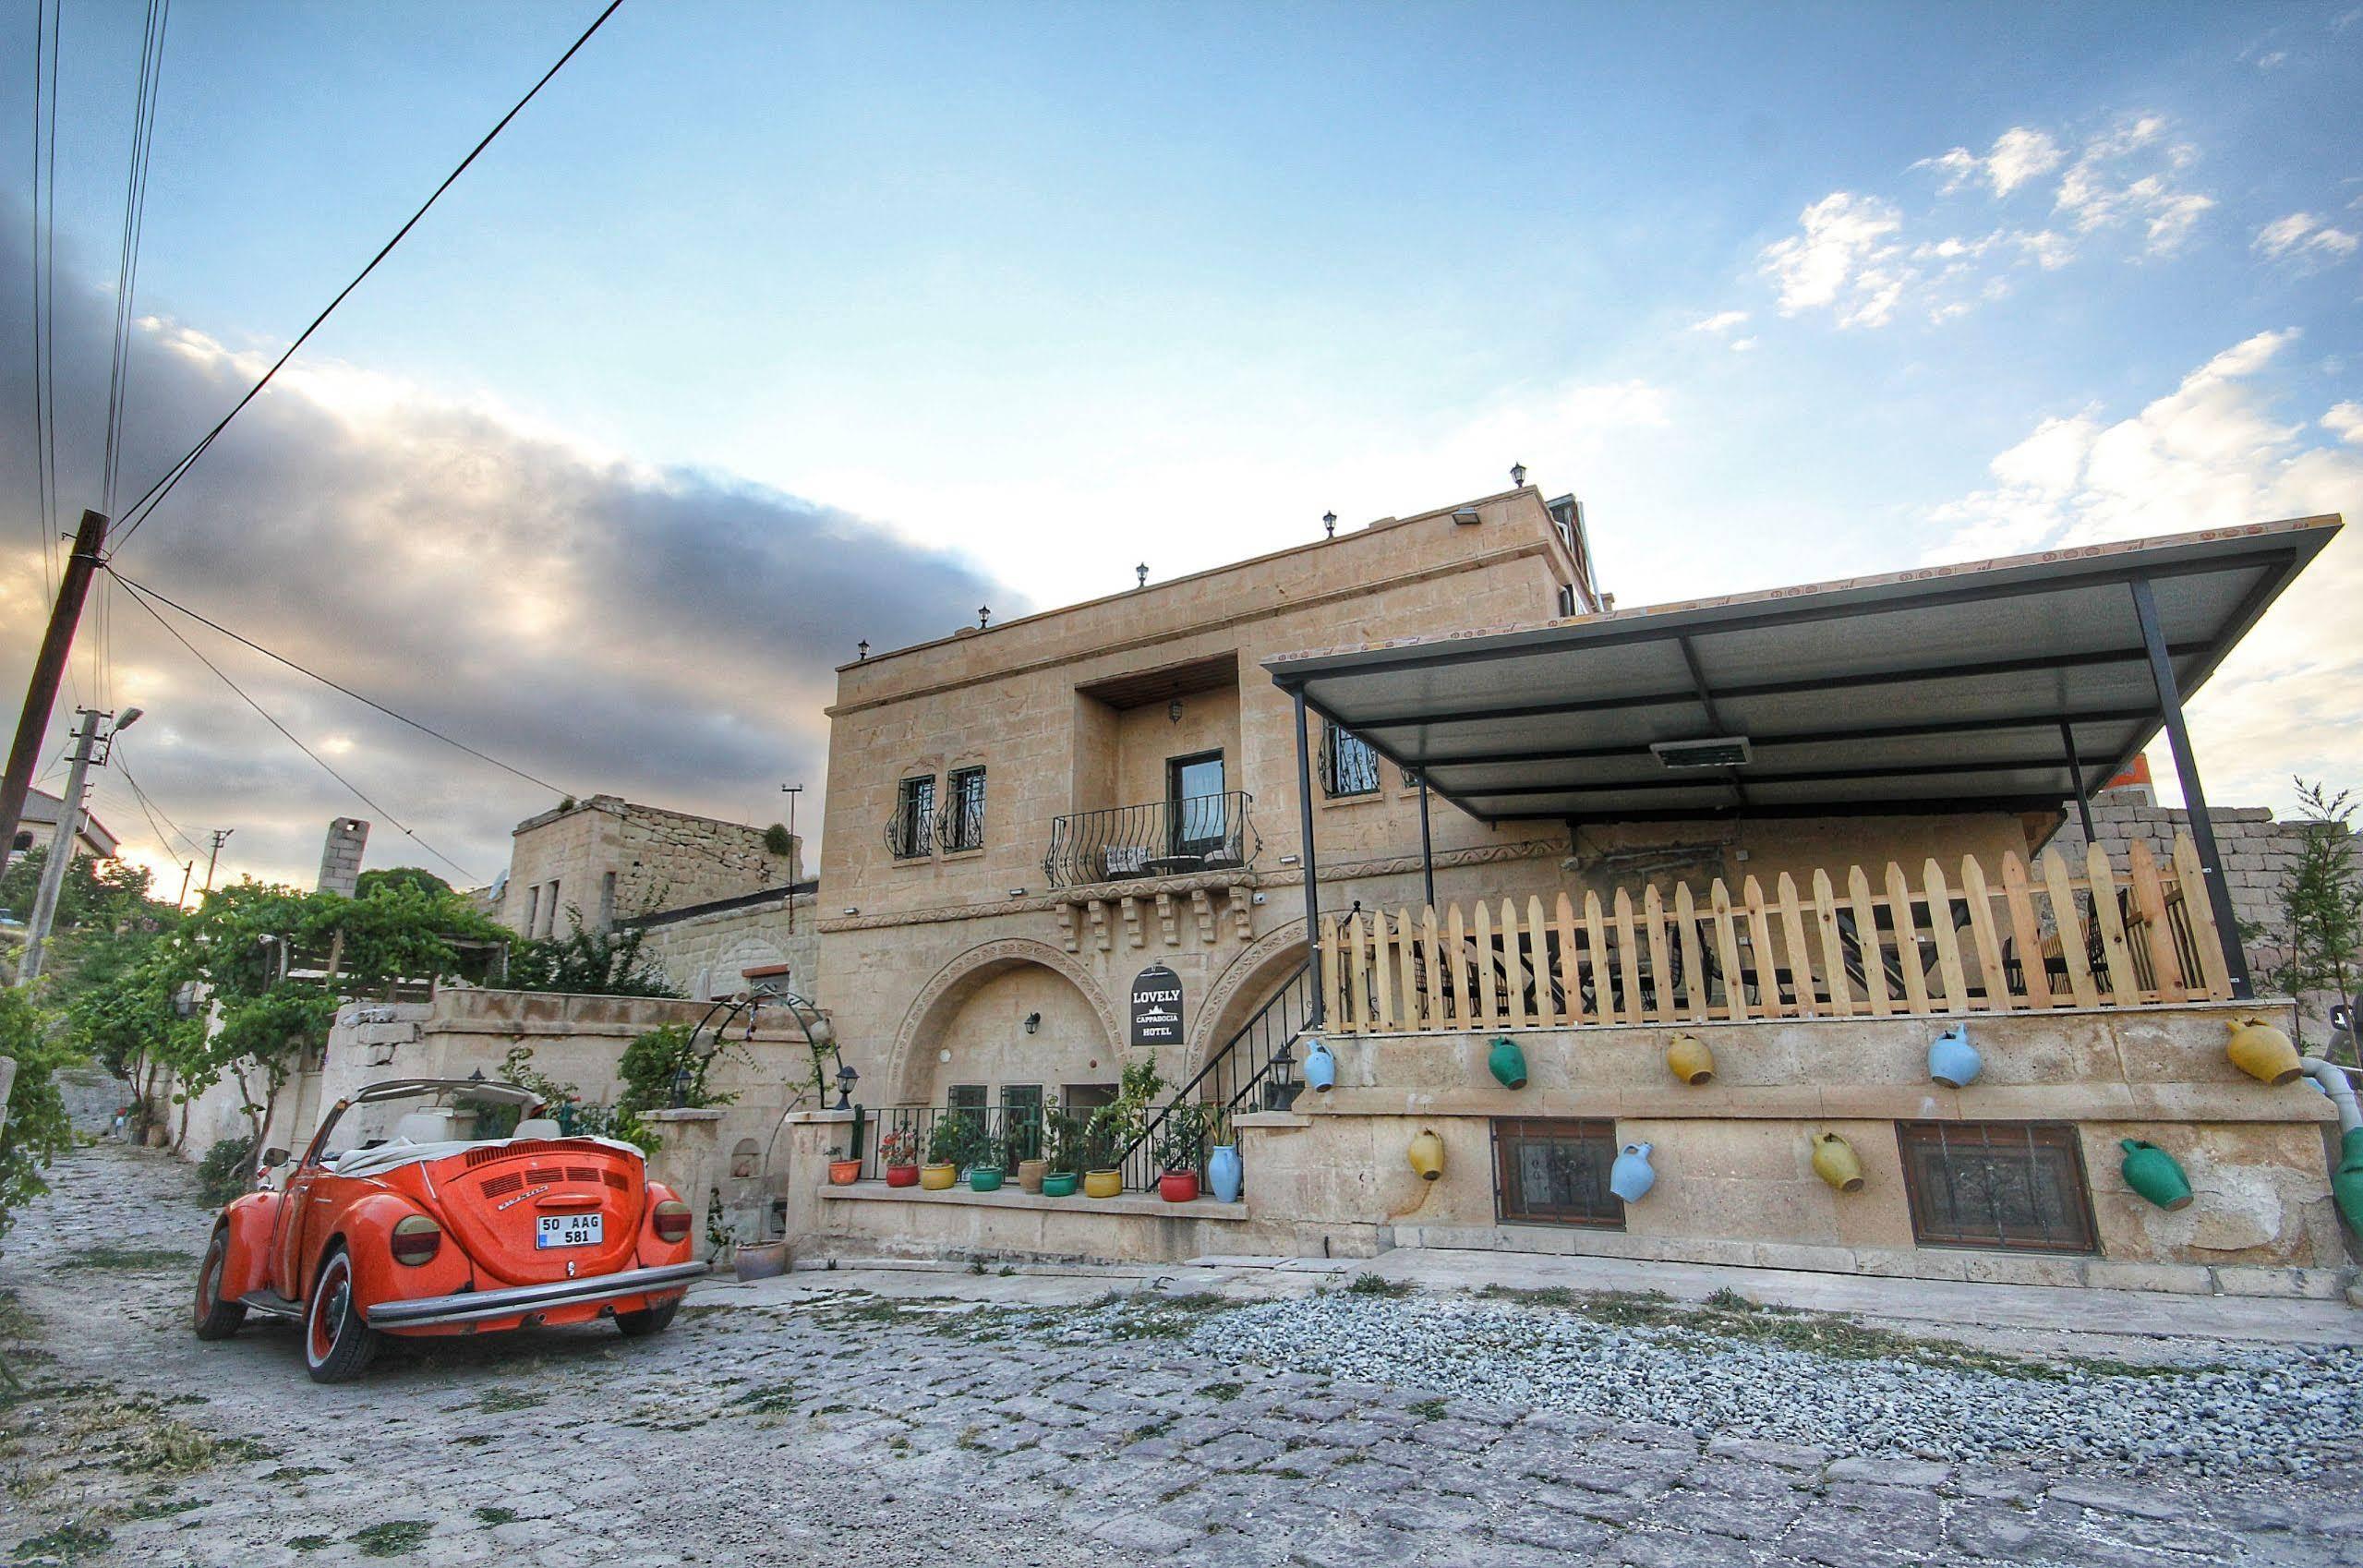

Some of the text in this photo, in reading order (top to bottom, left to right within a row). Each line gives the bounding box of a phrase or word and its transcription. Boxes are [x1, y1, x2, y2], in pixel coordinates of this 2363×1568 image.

[1133, 990, 1180, 1003] LOVELY
[1136, 1015, 1178, 1023] CAPPADOCIA
[1142, 1027, 1172, 1036] HOTEL
[543, 1216, 598, 1230] 50 AAG
[565, 1231, 588, 1243] 581
